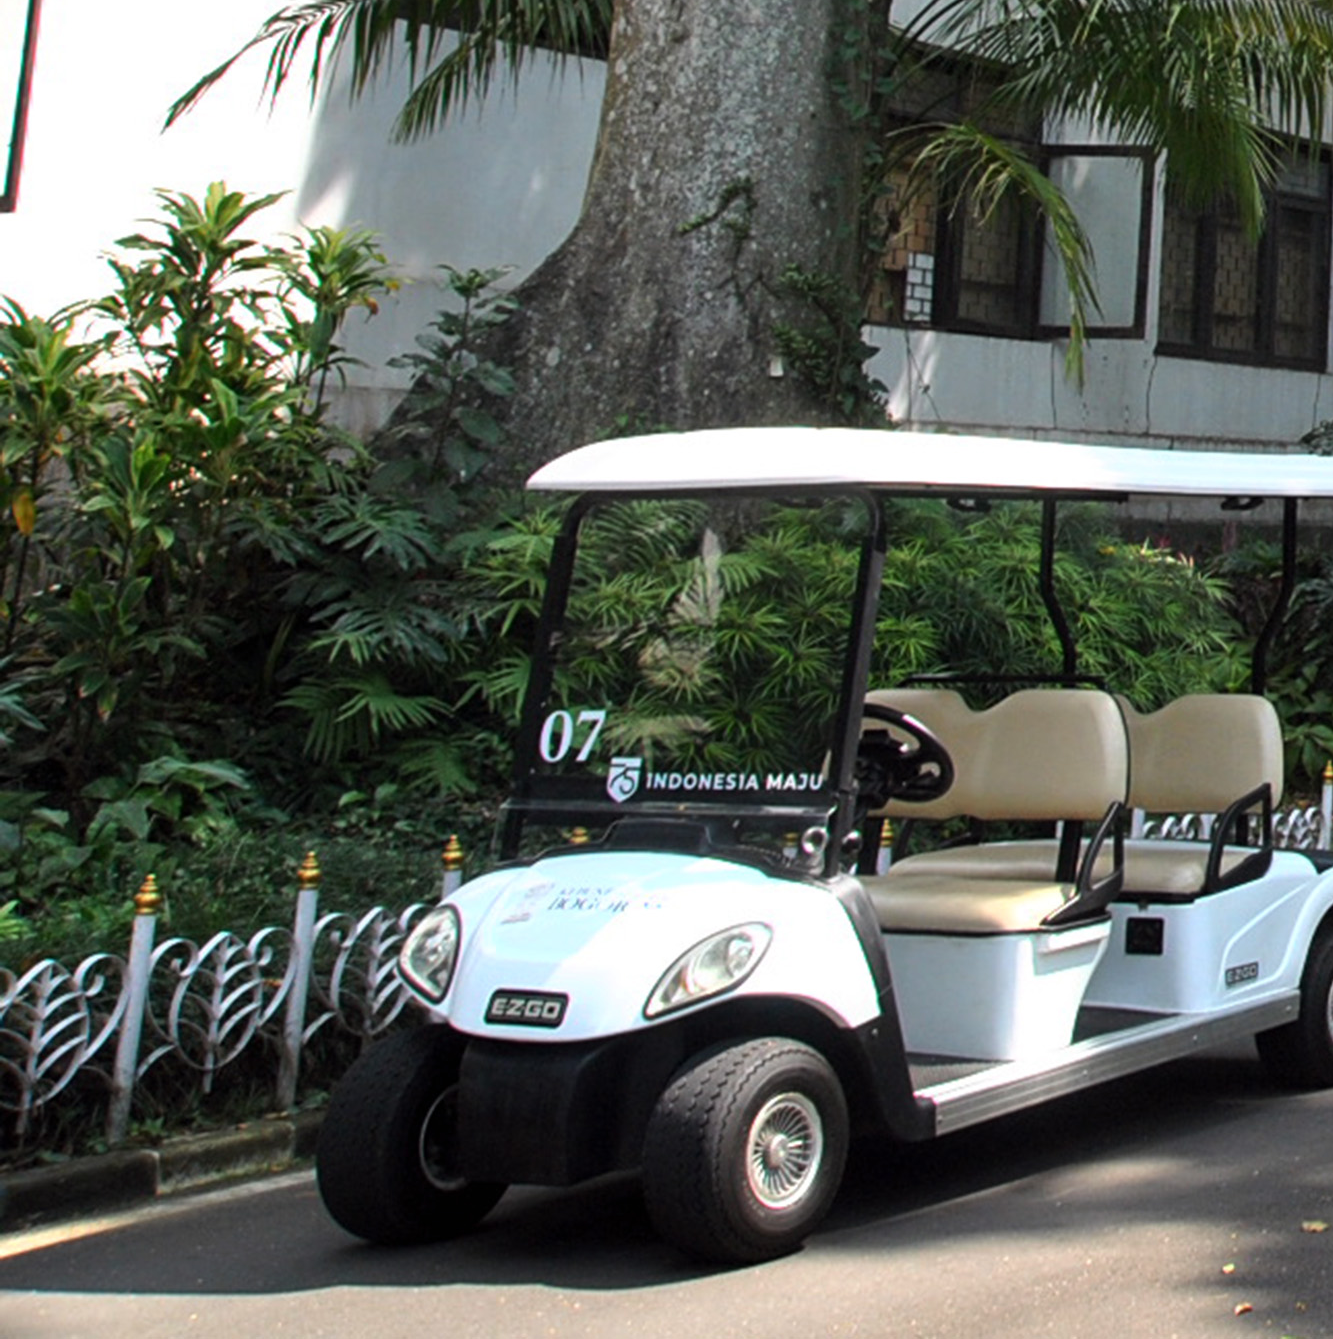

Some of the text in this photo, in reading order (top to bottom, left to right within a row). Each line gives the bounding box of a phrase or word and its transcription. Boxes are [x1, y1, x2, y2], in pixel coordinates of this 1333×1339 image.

[538, 709, 607, 763] 07
[646, 772, 759, 791] INDONESIA
[765, 772, 825, 791] MAJU
